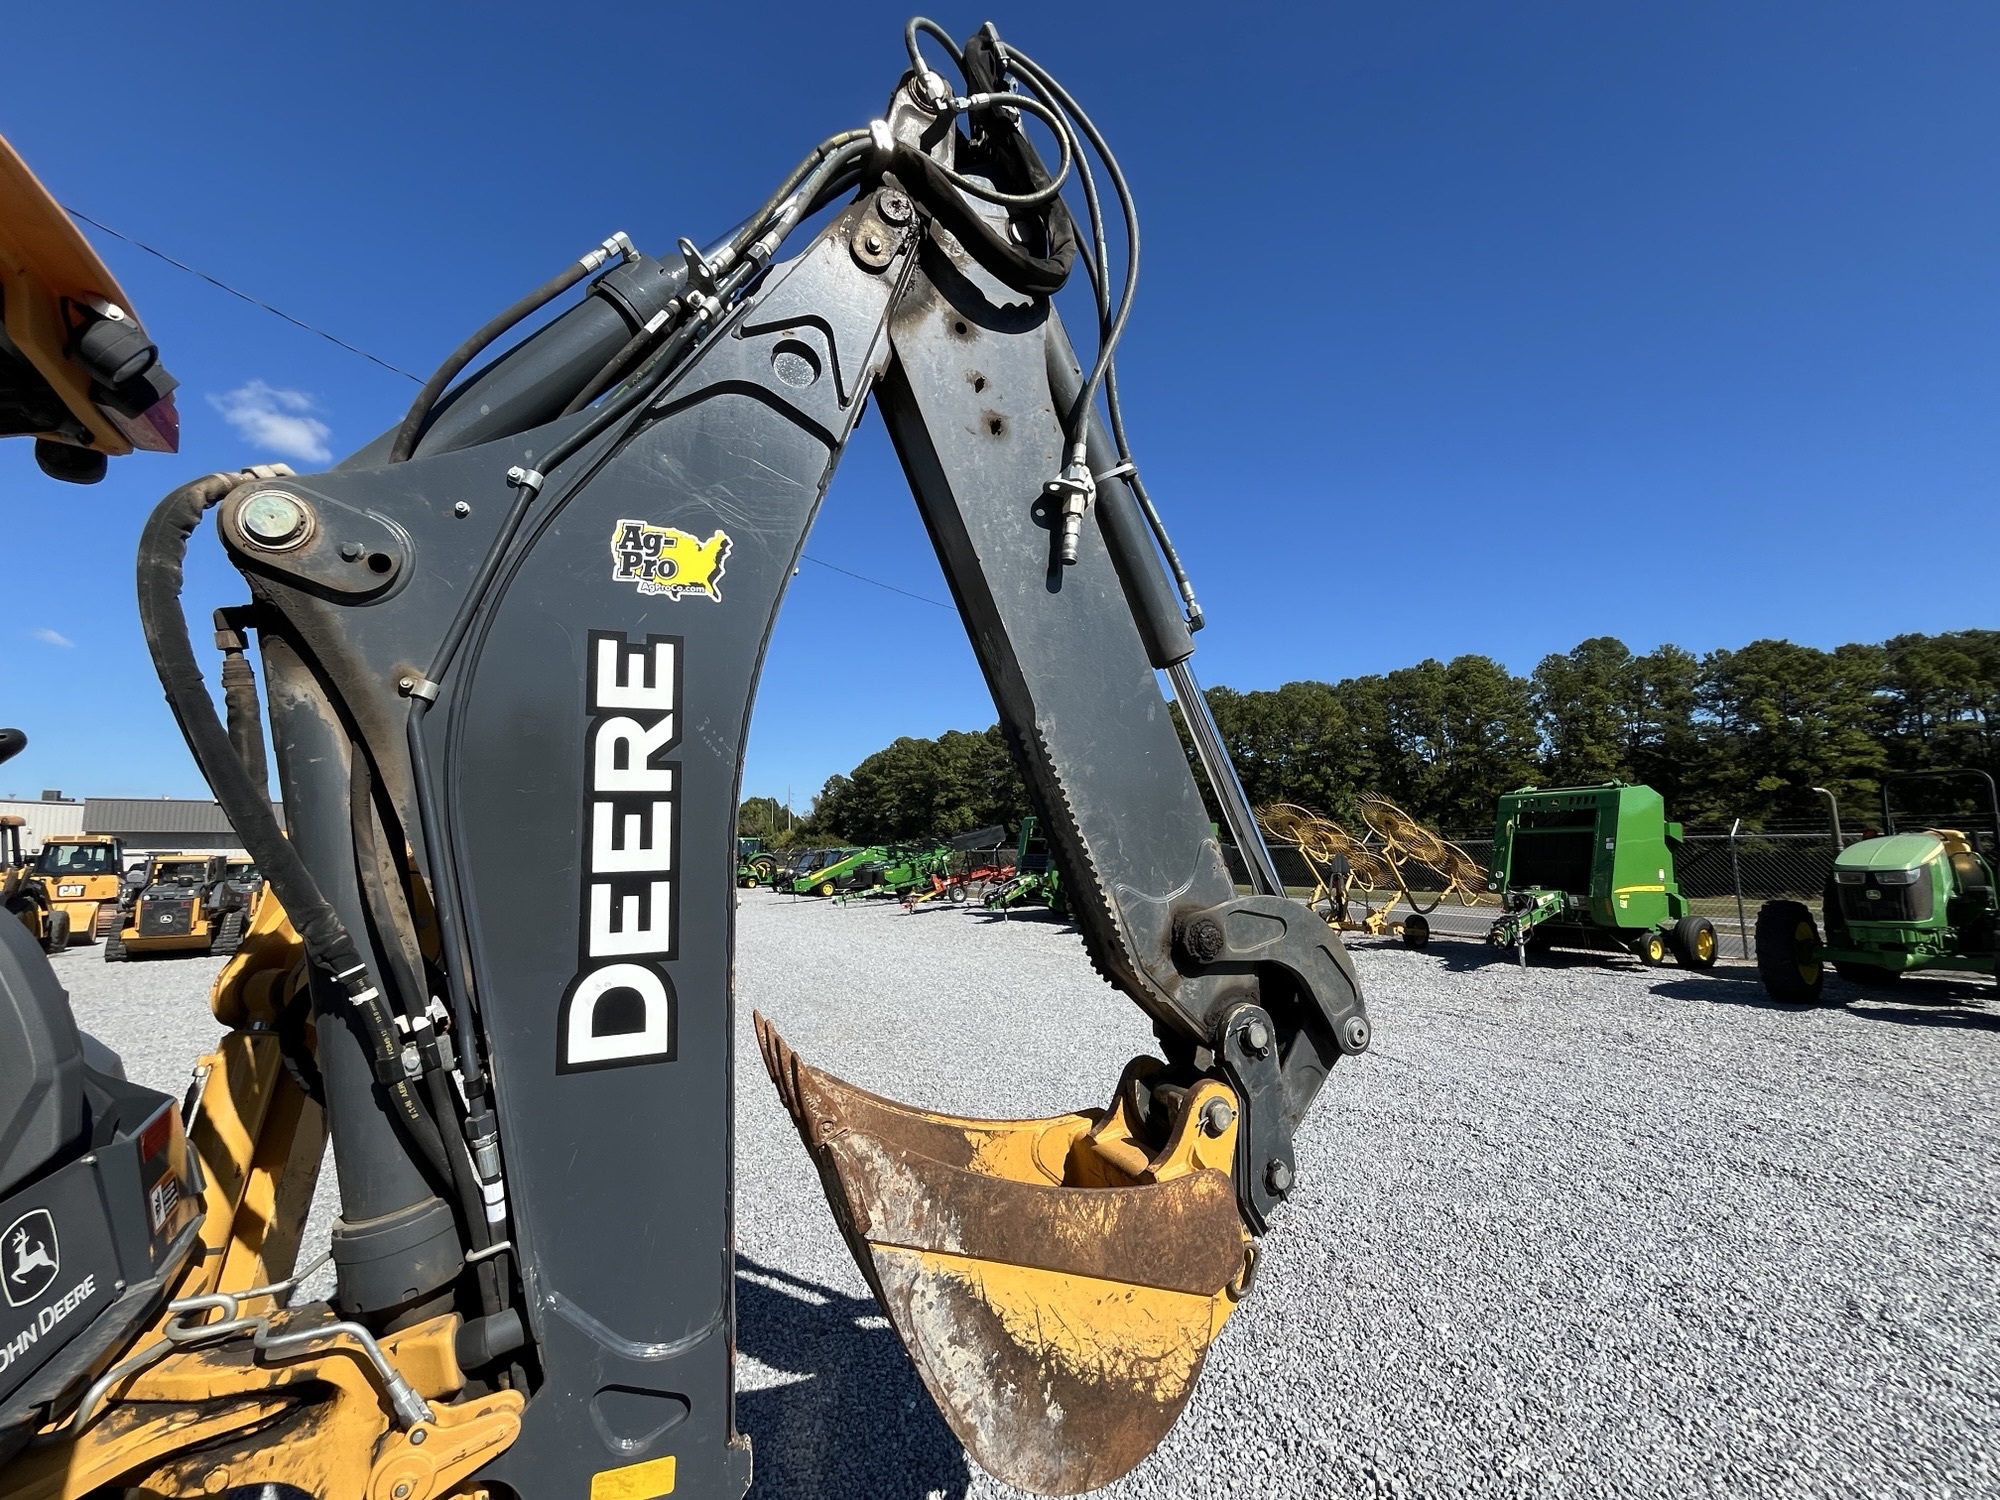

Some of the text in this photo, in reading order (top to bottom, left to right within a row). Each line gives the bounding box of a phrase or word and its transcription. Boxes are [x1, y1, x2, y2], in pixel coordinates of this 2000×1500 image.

[619, 525, 674, 557] Ag-
[619, 551, 676, 578] Pro
[641, 582, 705, 593] AgProCo.com
[566, 638, 675, 1065] DEERE
[58, 885, 84, 897] CAT
[0, 1273, 96, 1373] OHN DEERE
